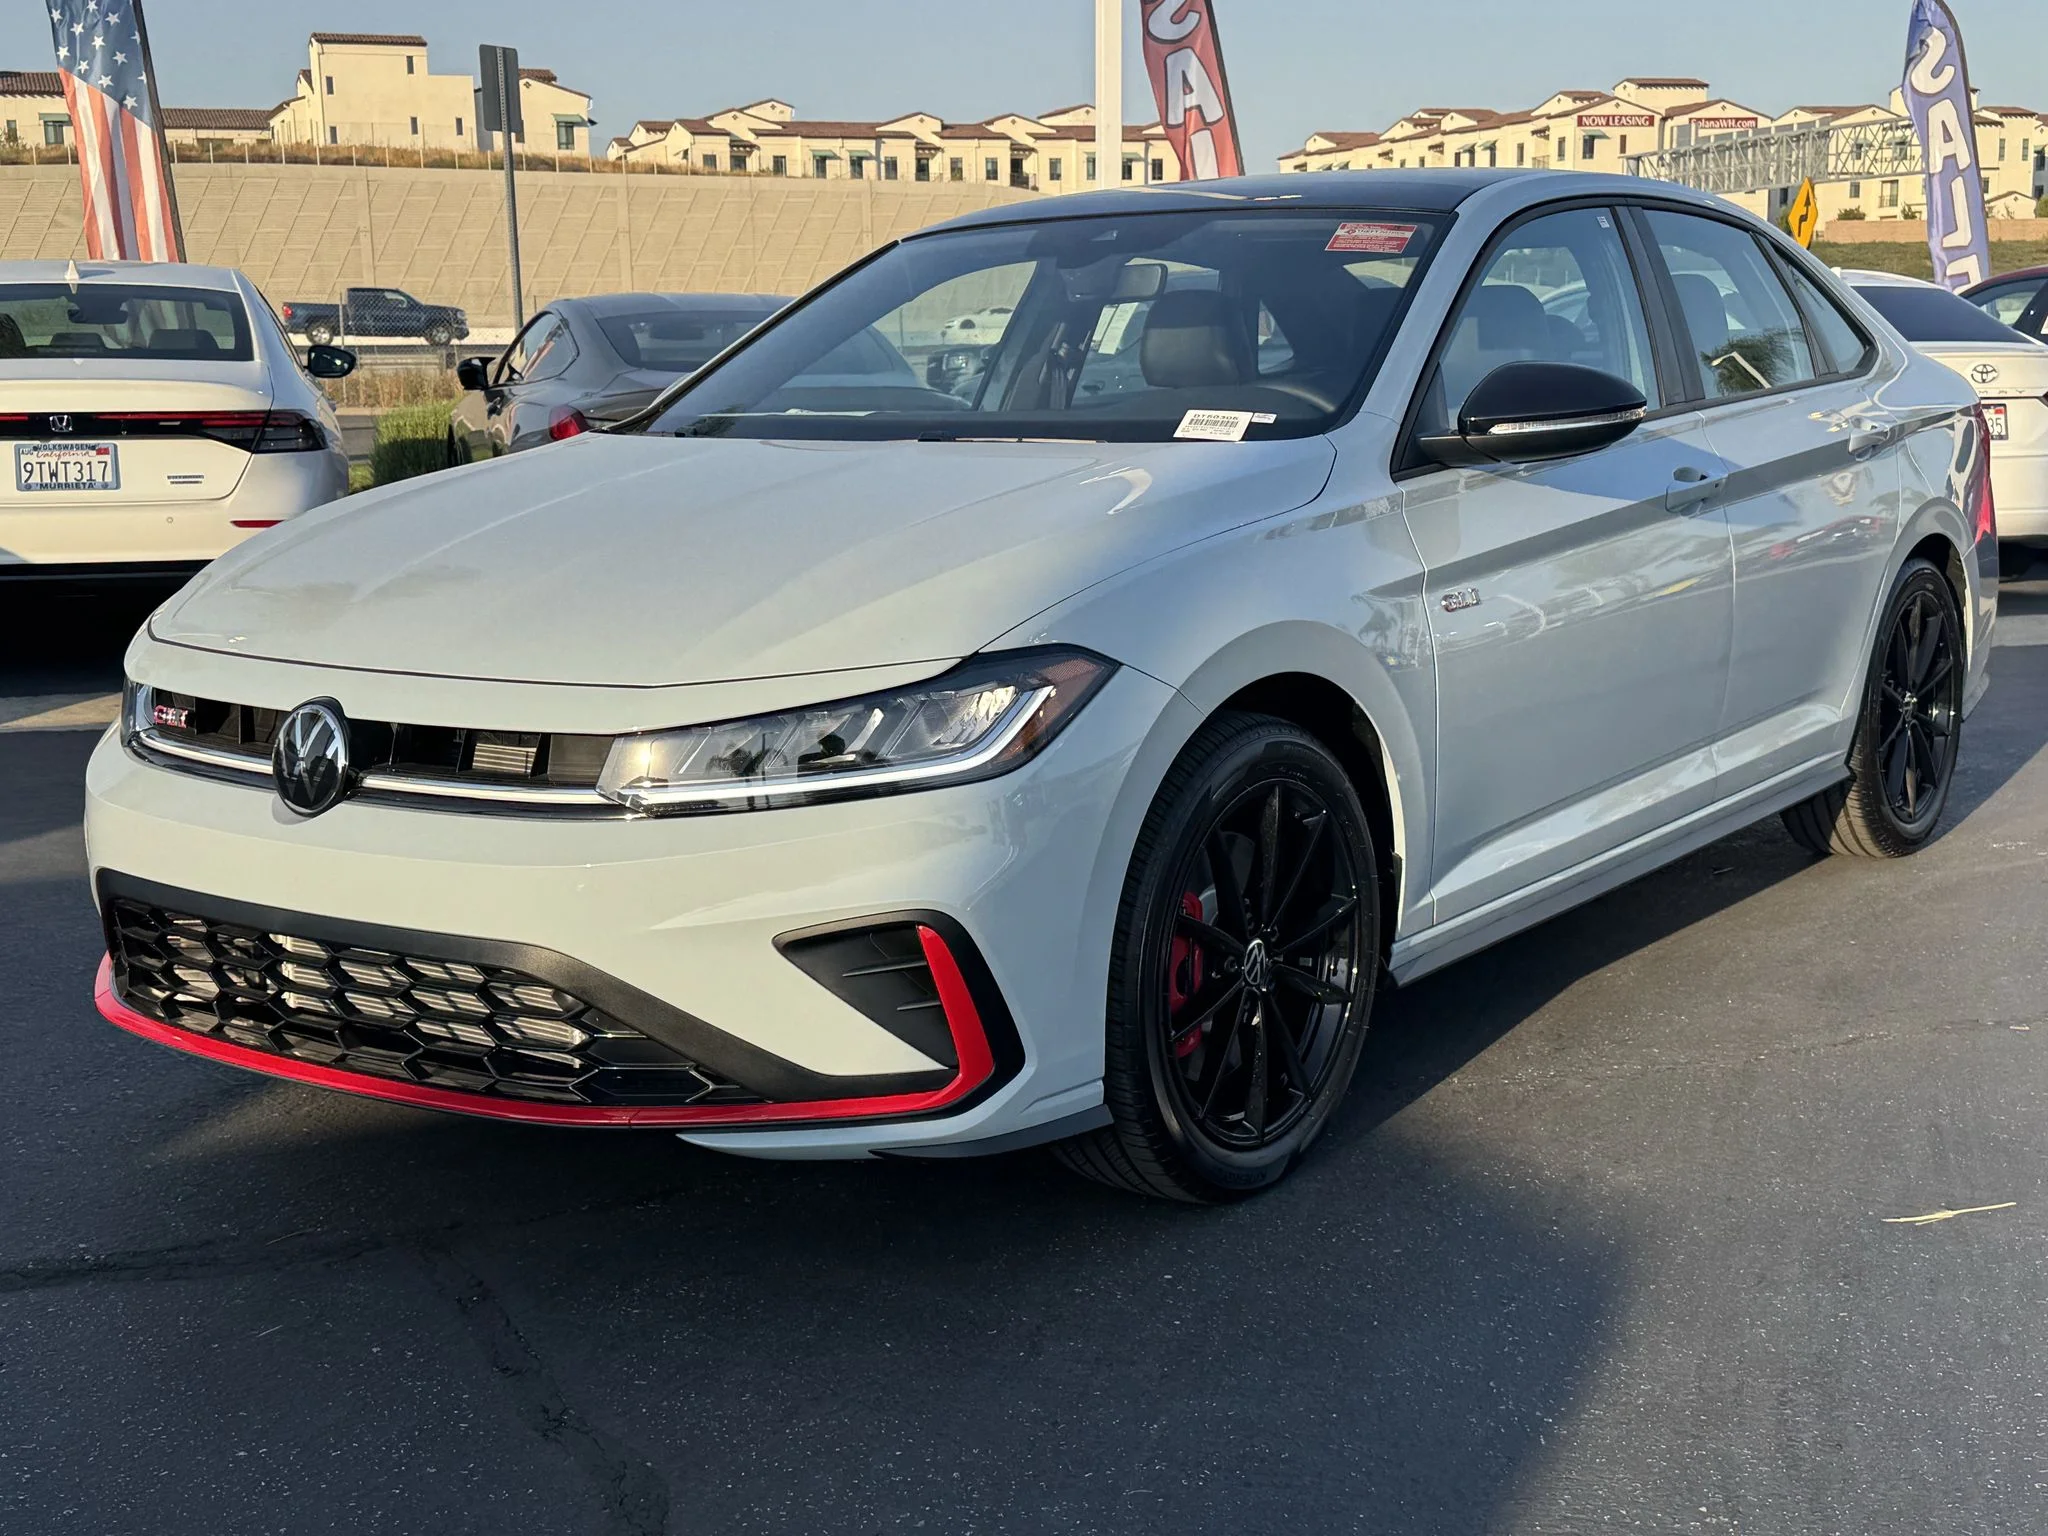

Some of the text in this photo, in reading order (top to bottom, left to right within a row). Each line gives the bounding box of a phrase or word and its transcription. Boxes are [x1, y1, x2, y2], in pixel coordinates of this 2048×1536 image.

[1582, 115, 1649, 126] NOW LEASING
[37, 443, 91, 451] VOLKSWAGEN
[36, 450, 96, 461] California
[23, 460, 108, 483] 9TWT317
